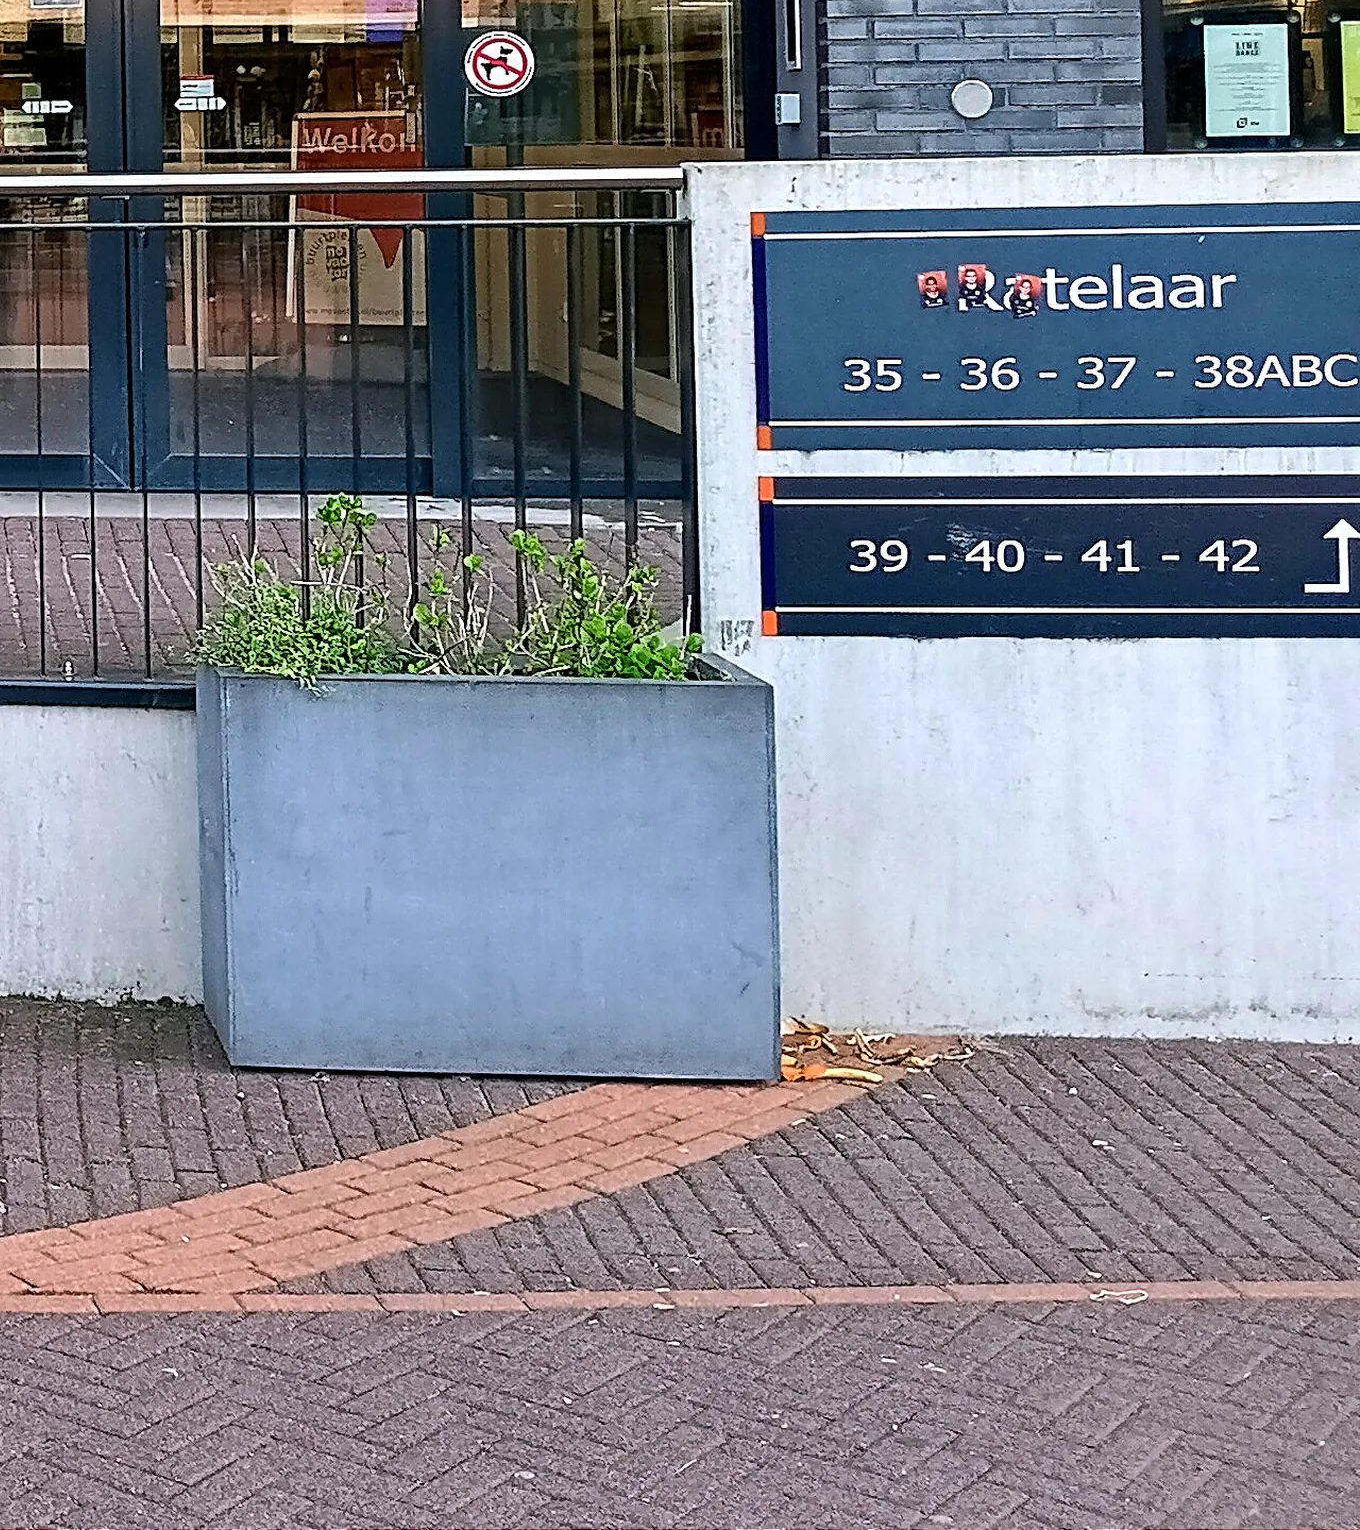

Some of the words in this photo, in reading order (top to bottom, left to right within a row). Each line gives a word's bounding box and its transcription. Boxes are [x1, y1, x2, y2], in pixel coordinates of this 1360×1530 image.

[843, 358, 903, 391] 35
[921, 371, 942, 381] -
[959, 357, 1021, 391] 36
[1037, 370, 1059, 379] -
[1076, 357, 1137, 390] 37
[1155, 369, 1176, 378] -
[1194, 354, 1360, 390] 38ABC
[848, 539, 910, 573] 39
[927, 554, 947, 562] -
[965, 539, 1026, 573] 40
[1043, 554, 1064, 562] -
[1080, 539, 1140, 573] 41
[1161, 553, 1180, 561] -
[1198, 539, 1260, 573] 42
